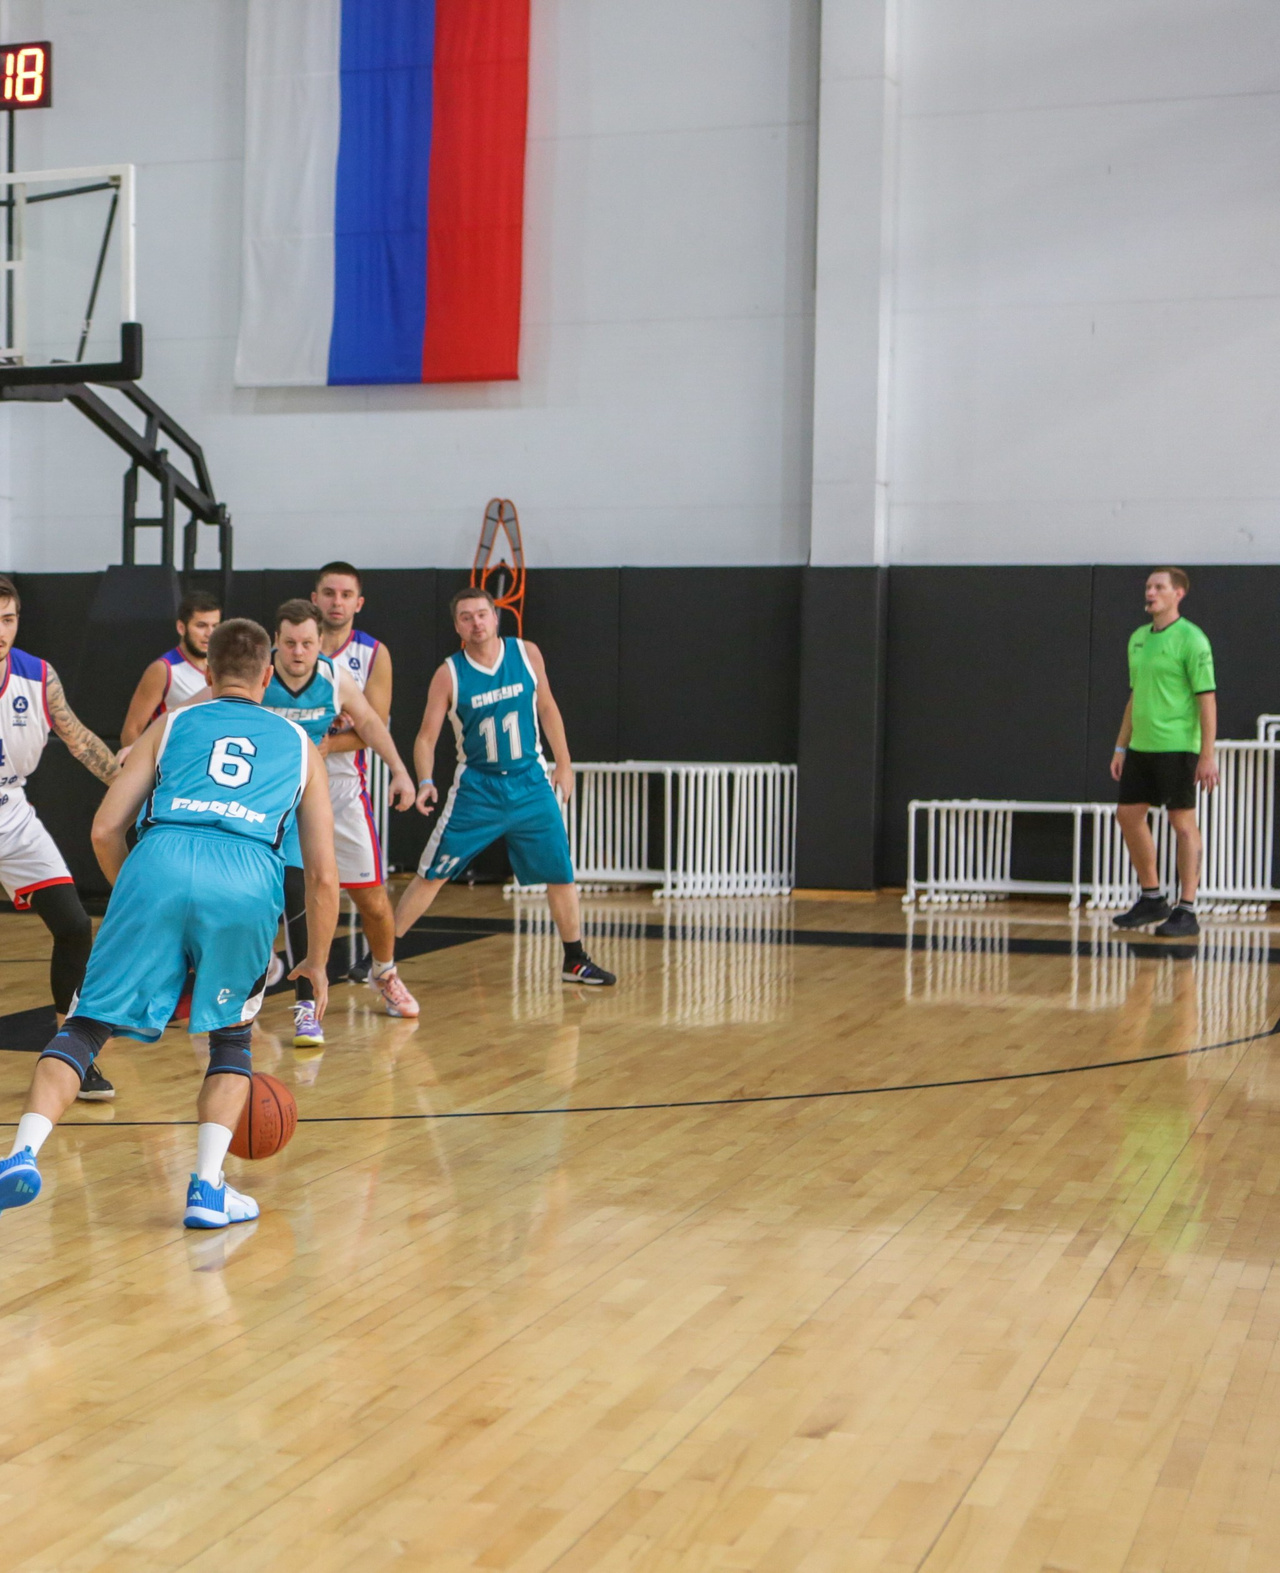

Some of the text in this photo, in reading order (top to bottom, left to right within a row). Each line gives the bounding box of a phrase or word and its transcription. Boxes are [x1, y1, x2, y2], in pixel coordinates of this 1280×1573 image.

[4, 48, 44, 102] 18
[472, 683, 524, 709] СИБУР
[207, 735, 258, 789] 6
[479, 711, 523, 763] 11
